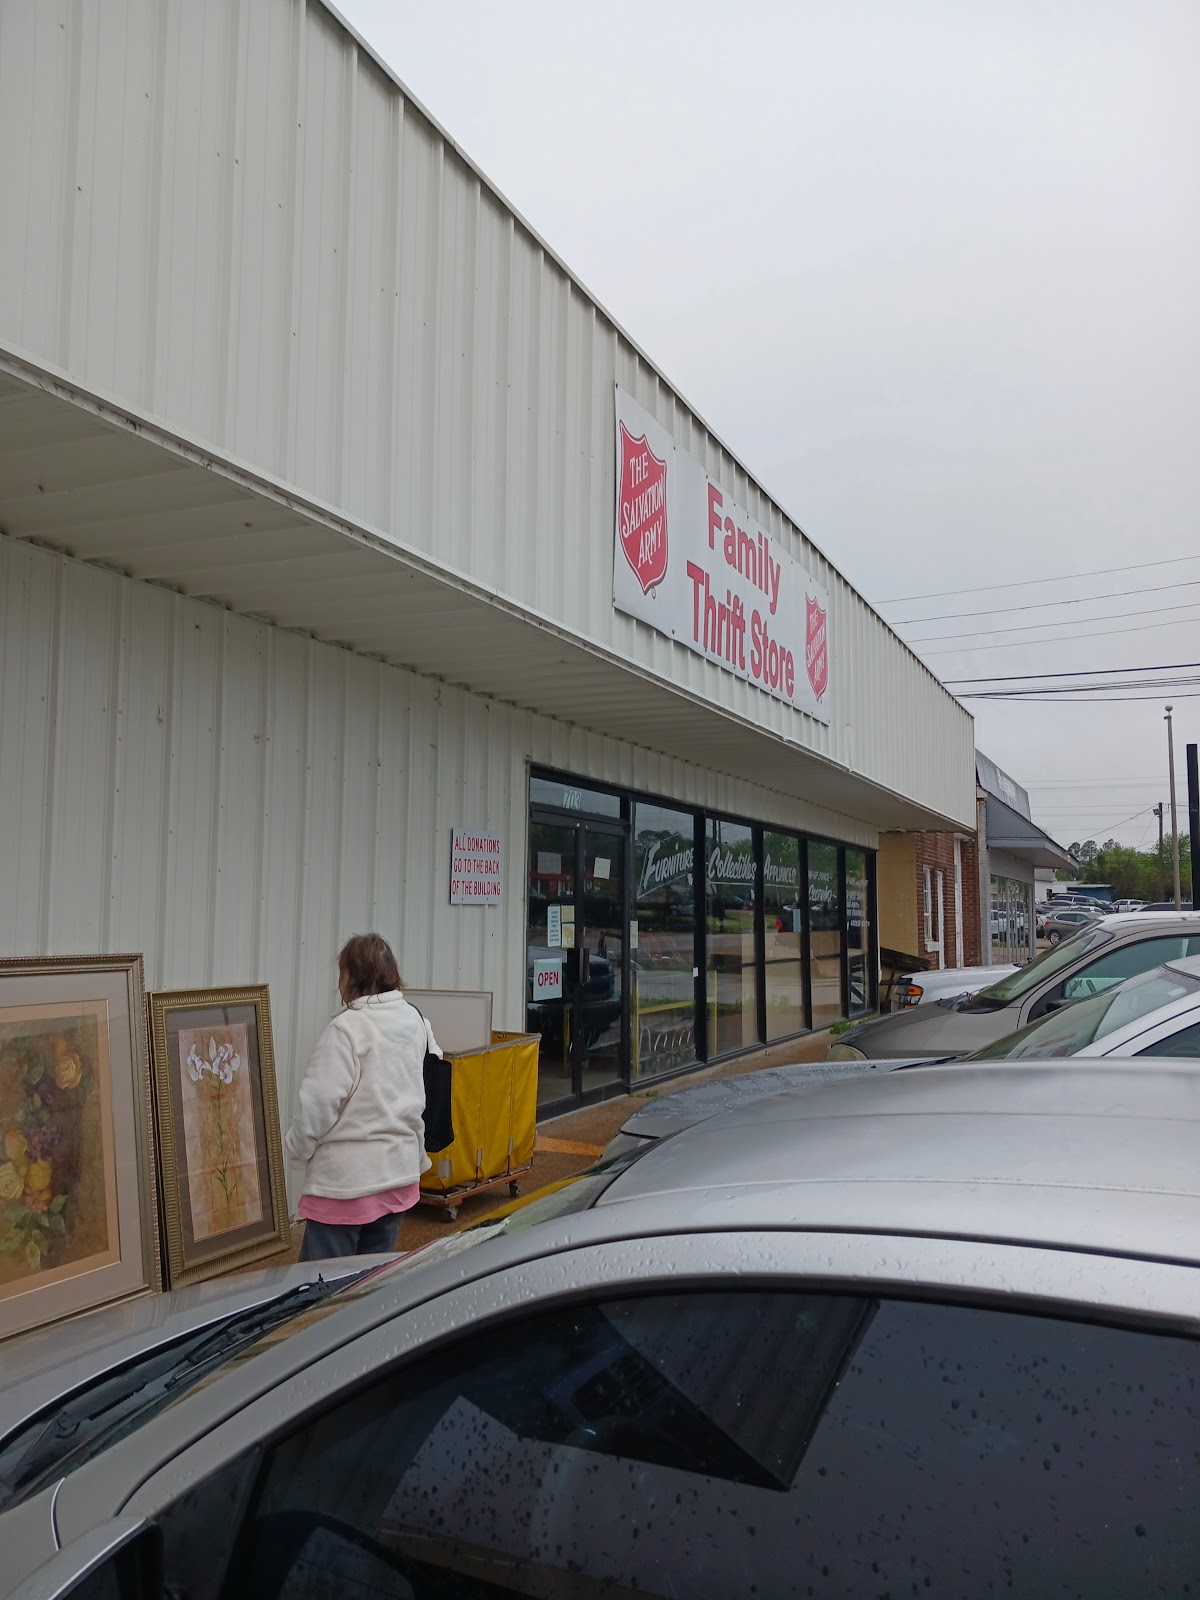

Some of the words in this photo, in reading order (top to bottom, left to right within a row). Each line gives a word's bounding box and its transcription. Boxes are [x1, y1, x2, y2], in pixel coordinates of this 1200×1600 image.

[630, 452, 649, 489] THE
[622, 474, 664, 539] SALVATION
[638, 515, 662, 569] ARMY
[707, 482, 781, 615] Family
[686, 560, 746, 671] Thrift
[751, 609, 795, 698] Store
[455, 836, 466, 851] ALL
[468, 837, 500, 854] DONATIONS
[454, 858, 462, 873] GO
[464, 858, 471, 873] TO
[473, 859, 483, 874] THE
[485, 860, 500, 875] BACK
[452, 880, 460, 895] OF
[462, 880, 473, 895] THE
[474, 881, 501, 896] BUILDING
[538, 971, 559, 987] OPEN
